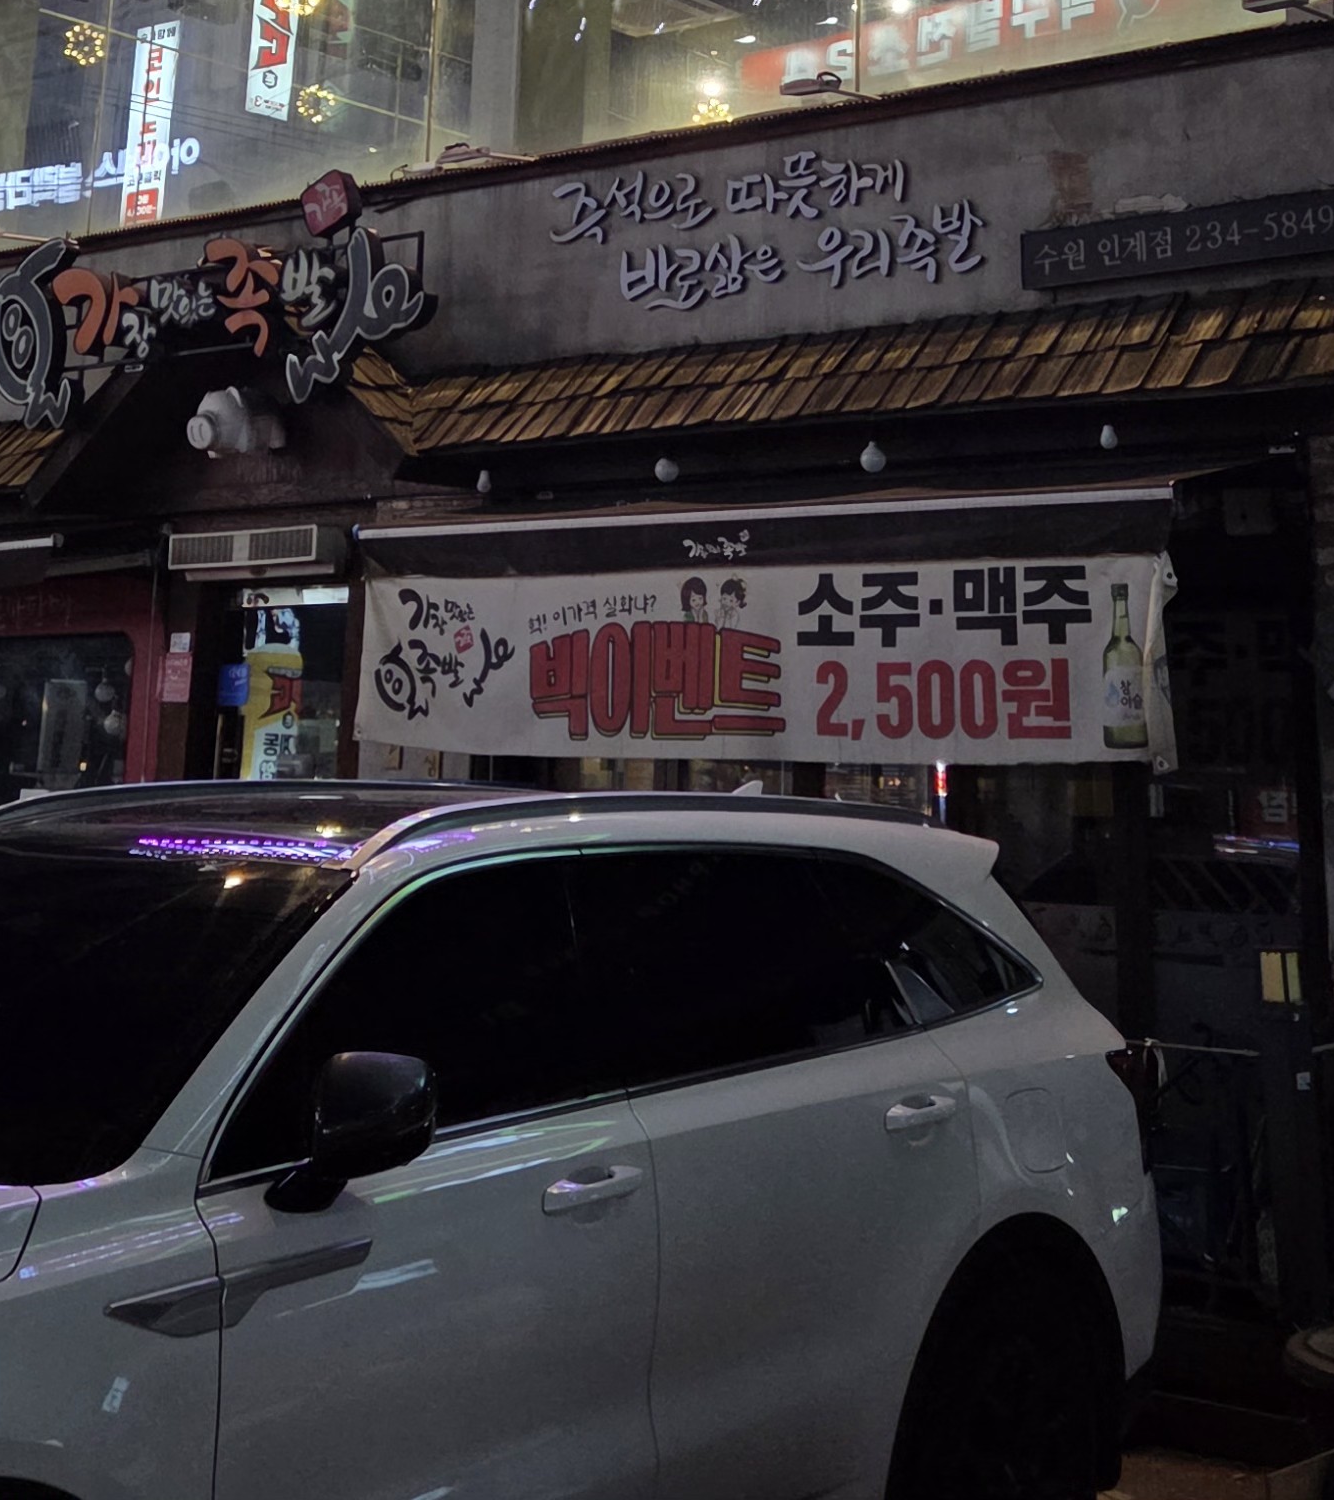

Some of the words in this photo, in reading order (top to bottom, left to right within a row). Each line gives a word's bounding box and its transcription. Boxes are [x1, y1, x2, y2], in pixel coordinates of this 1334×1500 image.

[550, 170, 716, 244] 즉석으로
[725, 151, 907, 216] 따뜻하게
[619, 231, 786, 311] 바로삶은
[796, 198, 985, 287] 우리족발
[1033, 236, 1085, 274] 수원
[1097, 227, 1174, 268] 인계점
[52, 267, 156, 359] 가장
[150, 278, 217, 325] 맛있는
[204, 238, 337, 357] 족발
[552, 598, 598, 625] 이가격
[602, 593, 658, 617] 실화냐?
[795, 564, 1093, 649] 소주·맥주
[408, 638, 465, 699] 족발
[529, 619, 786, 740] 빅이벤트
[815, 659, 1073, 741] 2,500원
